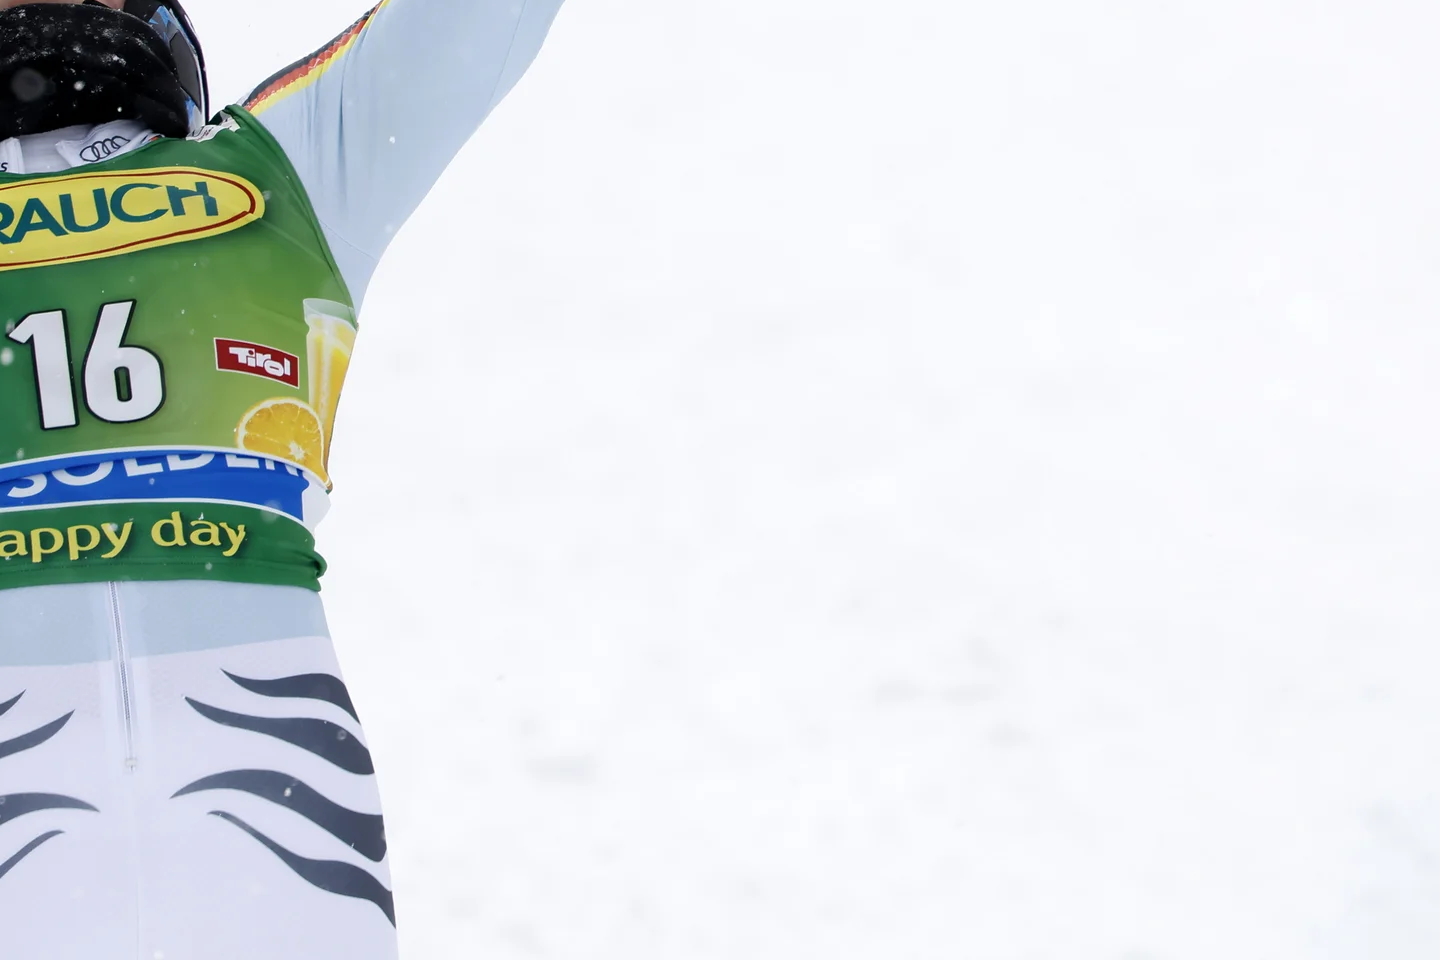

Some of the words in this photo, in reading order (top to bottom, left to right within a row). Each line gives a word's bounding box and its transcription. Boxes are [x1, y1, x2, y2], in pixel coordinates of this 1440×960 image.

[5, 299, 167, 431] 16
[228, 346, 291, 377] Tirol
[151, 511, 246, 557] day
